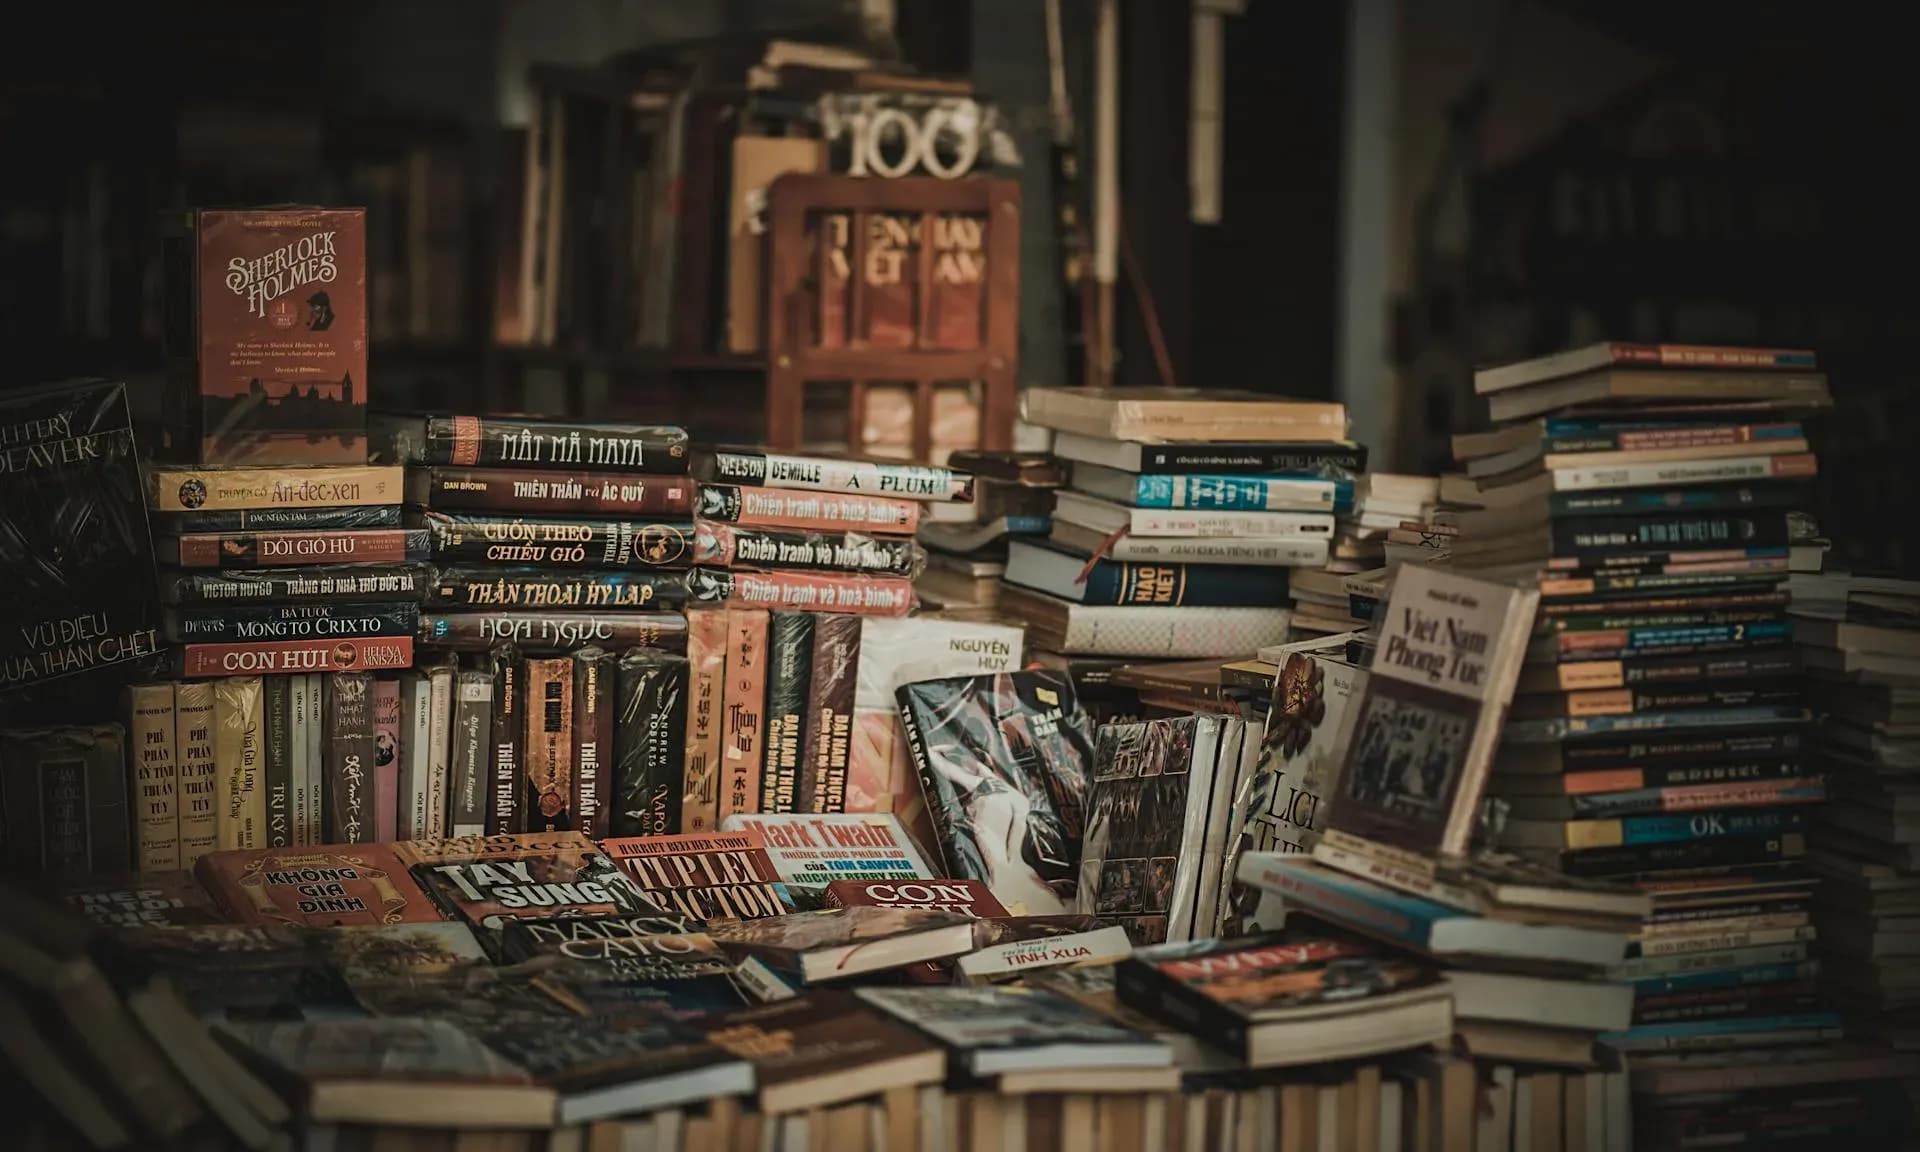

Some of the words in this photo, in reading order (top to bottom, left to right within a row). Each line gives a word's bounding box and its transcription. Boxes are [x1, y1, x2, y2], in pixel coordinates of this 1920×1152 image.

[226, 231, 337, 295] SHERLOCK
[248, 255, 338, 319] HOLMES
[550, 431, 581, 463] MÃ
[588, 438, 644, 466] MAYA
[721, 455, 765, 478] NELSON
[772, 461, 821, 483] DEMILLE
[443, 481, 459, 491] DAN
[460, 482, 487, 492] BROWN
[513, 479, 548, 499] THIÊN
[846, 474, 860, 489] A
[543, 525, 593, 542] THEO
[296, 537, 326, 555] GIÓ
[550, 543, 586, 562] GIÓ
[203, 583, 238, 599] VICTOR
[240, 581, 273, 597] HUYGO
[222, 651, 277, 671] CON
[363, 645, 402, 657] HELENA
[588, 666, 596, 684] DAN
[587, 685, 596, 713] BROWN
[648, 712, 658, 767] ROBERTS
[660, 713, 669, 766] ANDREW
[498, 742, 516, 780] THIÊN
[580, 741, 600, 779] THIÊN
[742, 820, 818, 849] Mark
[809, 819, 898, 849] Twain
[1690, 812, 1726, 836] OK
[618, 842, 665, 855] HARRIET
[715, 836, 752, 849] STOWE
[824, 860, 857, 870] TOM
[858, 860, 914, 870] SAWYER
[297, 882, 347, 897] GIA
[432, 861, 536, 901] TAY
[865, 884, 976, 902] CON
[526, 914, 695, 943] NANCY
